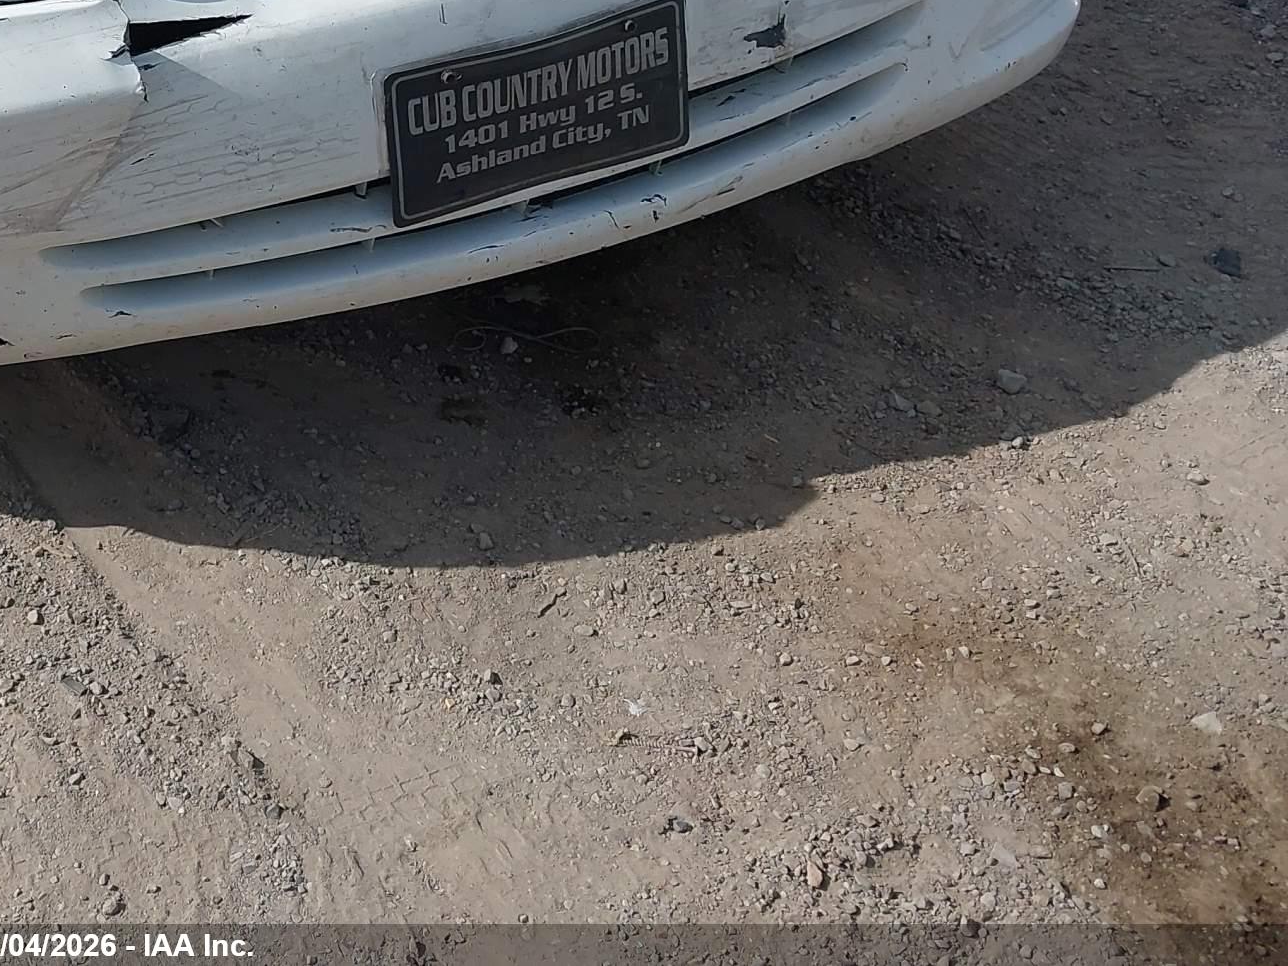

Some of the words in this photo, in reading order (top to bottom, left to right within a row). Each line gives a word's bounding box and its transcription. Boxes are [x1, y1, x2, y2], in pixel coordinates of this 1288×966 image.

[407, 89, 457, 135] CUB
[462, 58, 575, 122] COUNTRY
[577, 27, 669, 90] MOTORS
[444, 120, 509, 153] 1401
[520, 105, 576, 133] Hwy
[584, 89, 614, 114] 12
[619, 82, 643, 104] S.
[436, 135, 546, 183] Ashland
[552, 123, 612, 150] City,
[617, 105, 650, 130] TN
